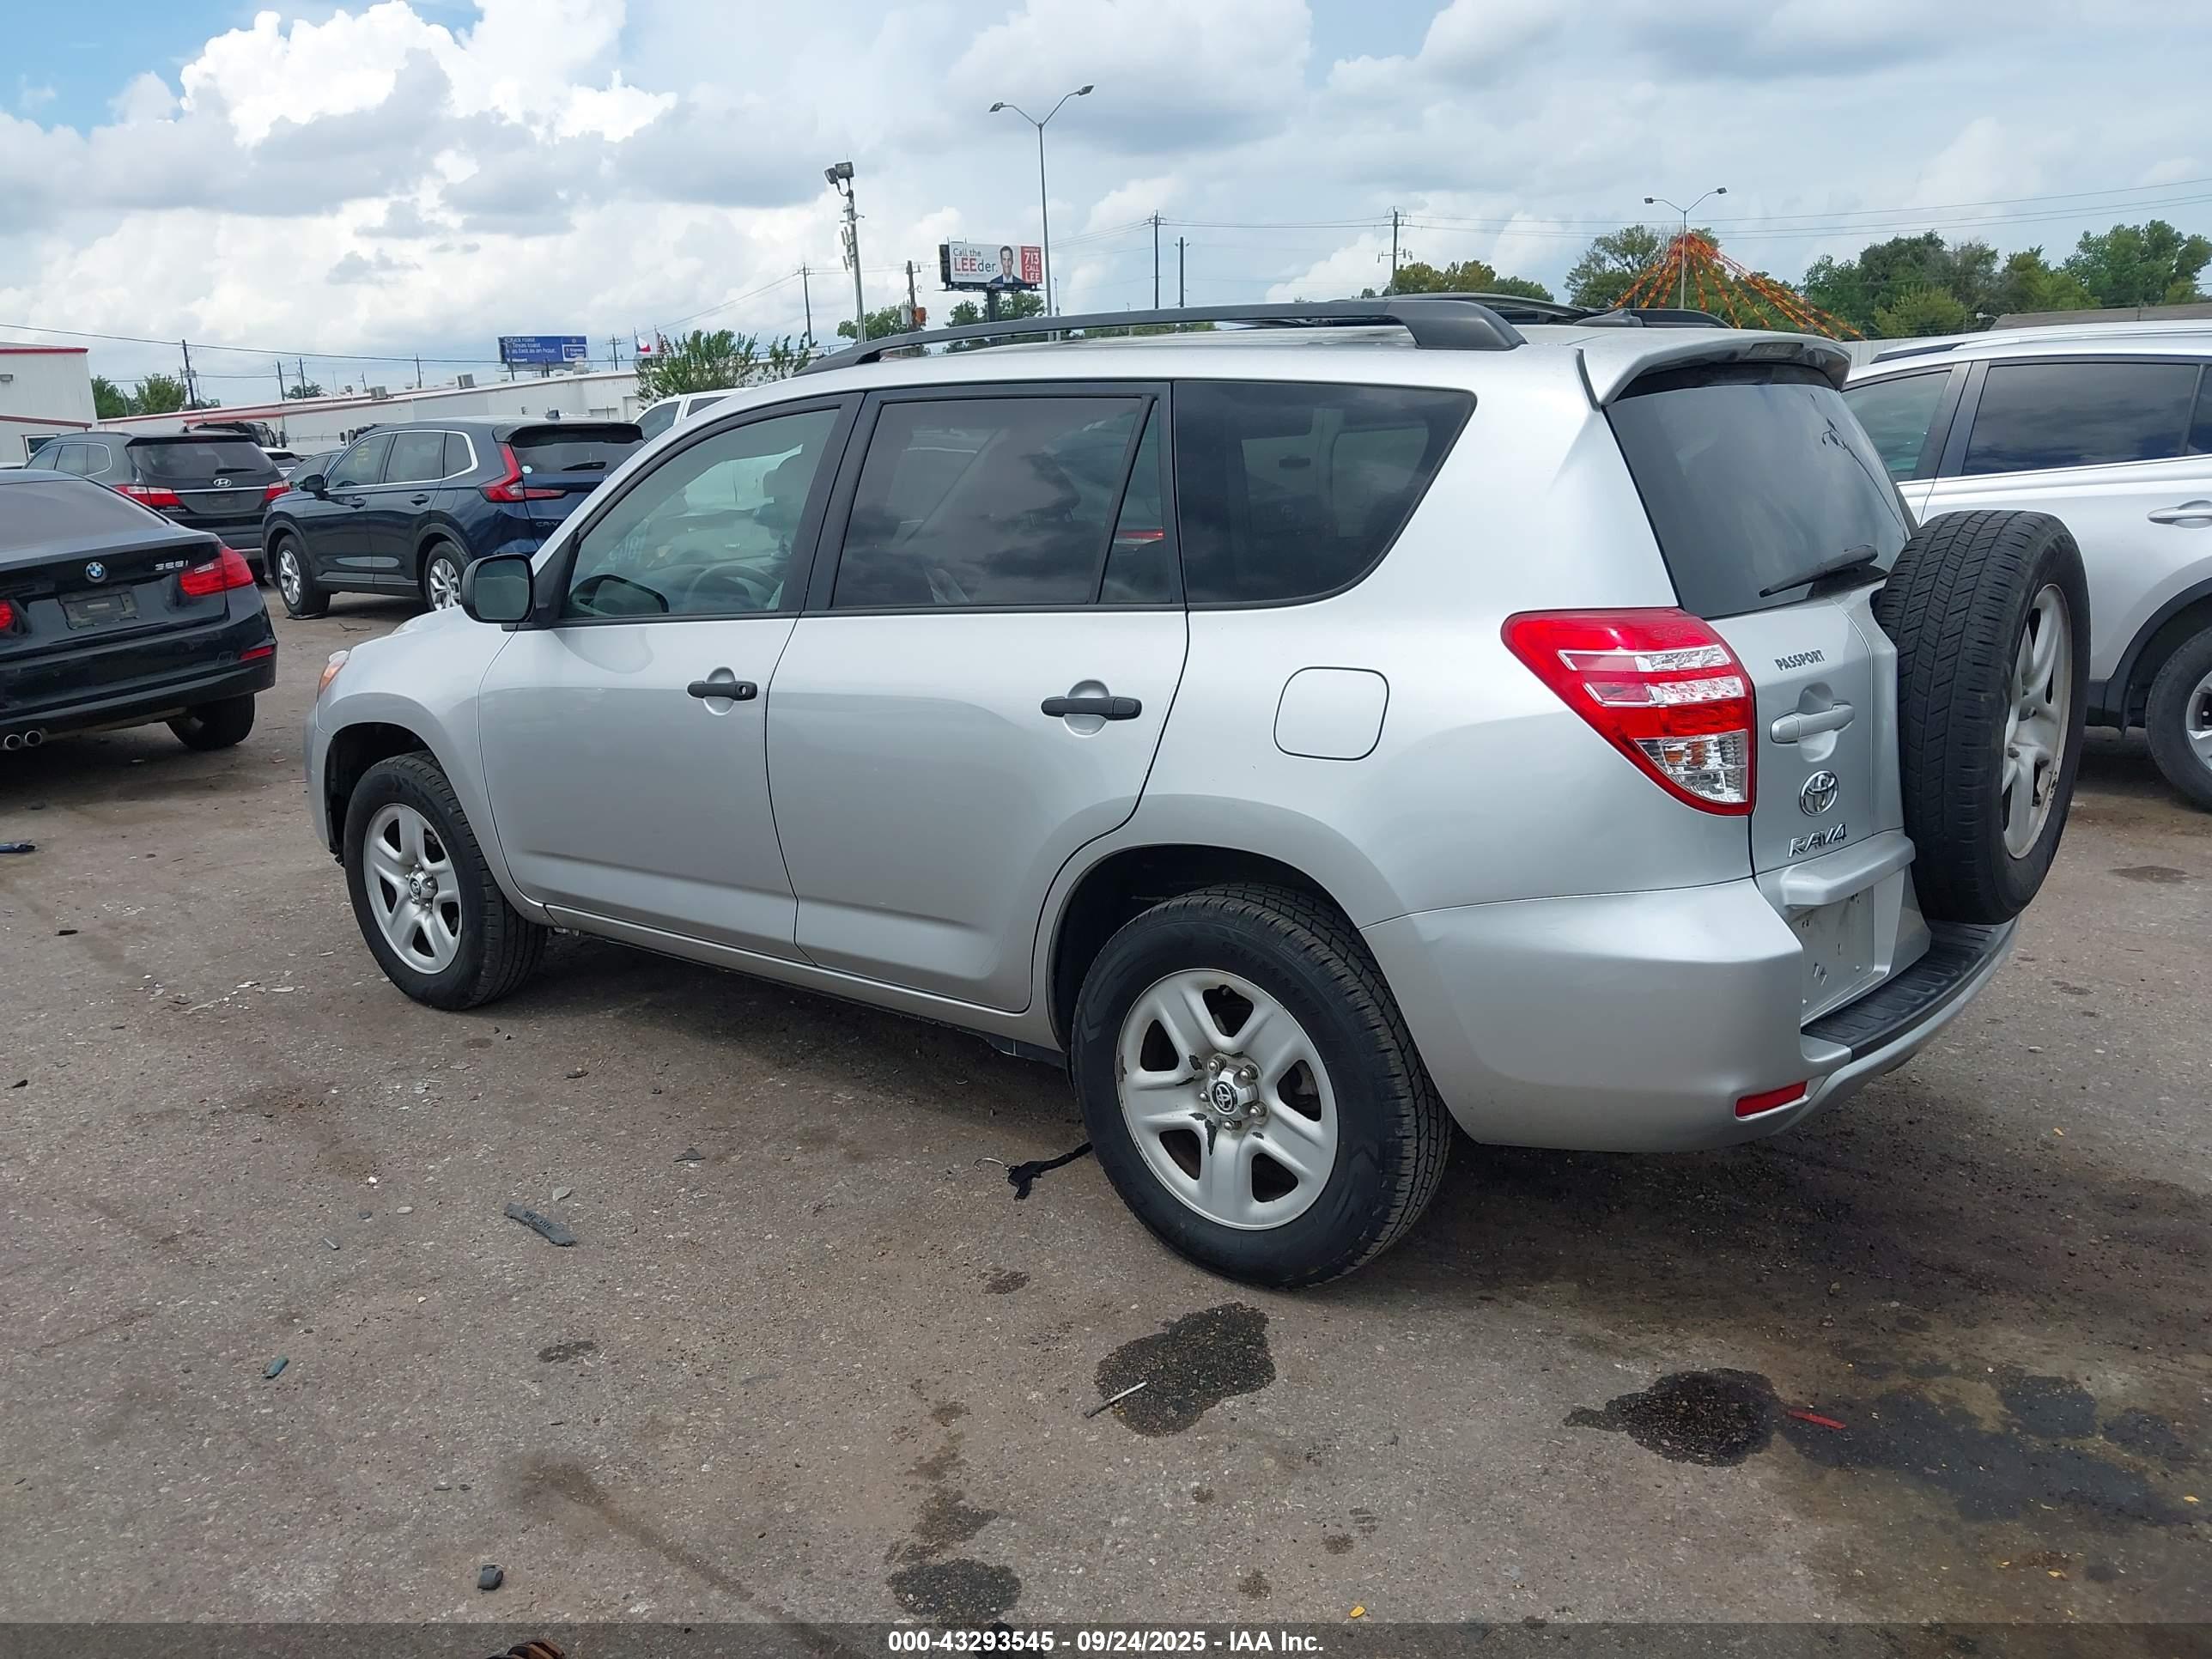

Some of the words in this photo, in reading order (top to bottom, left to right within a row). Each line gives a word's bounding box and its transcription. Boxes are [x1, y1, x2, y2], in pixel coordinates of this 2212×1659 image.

[952, 248, 968, 258] Call
[969, 248, 981, 258] the
[1024, 252, 1040, 264] 713
[954, 258, 999, 273] LEEder.
[1025, 272, 1041, 283] LEE
[1774, 649, 1826, 671] PASSPORT
[1787, 823, 1847, 859] RAV4
